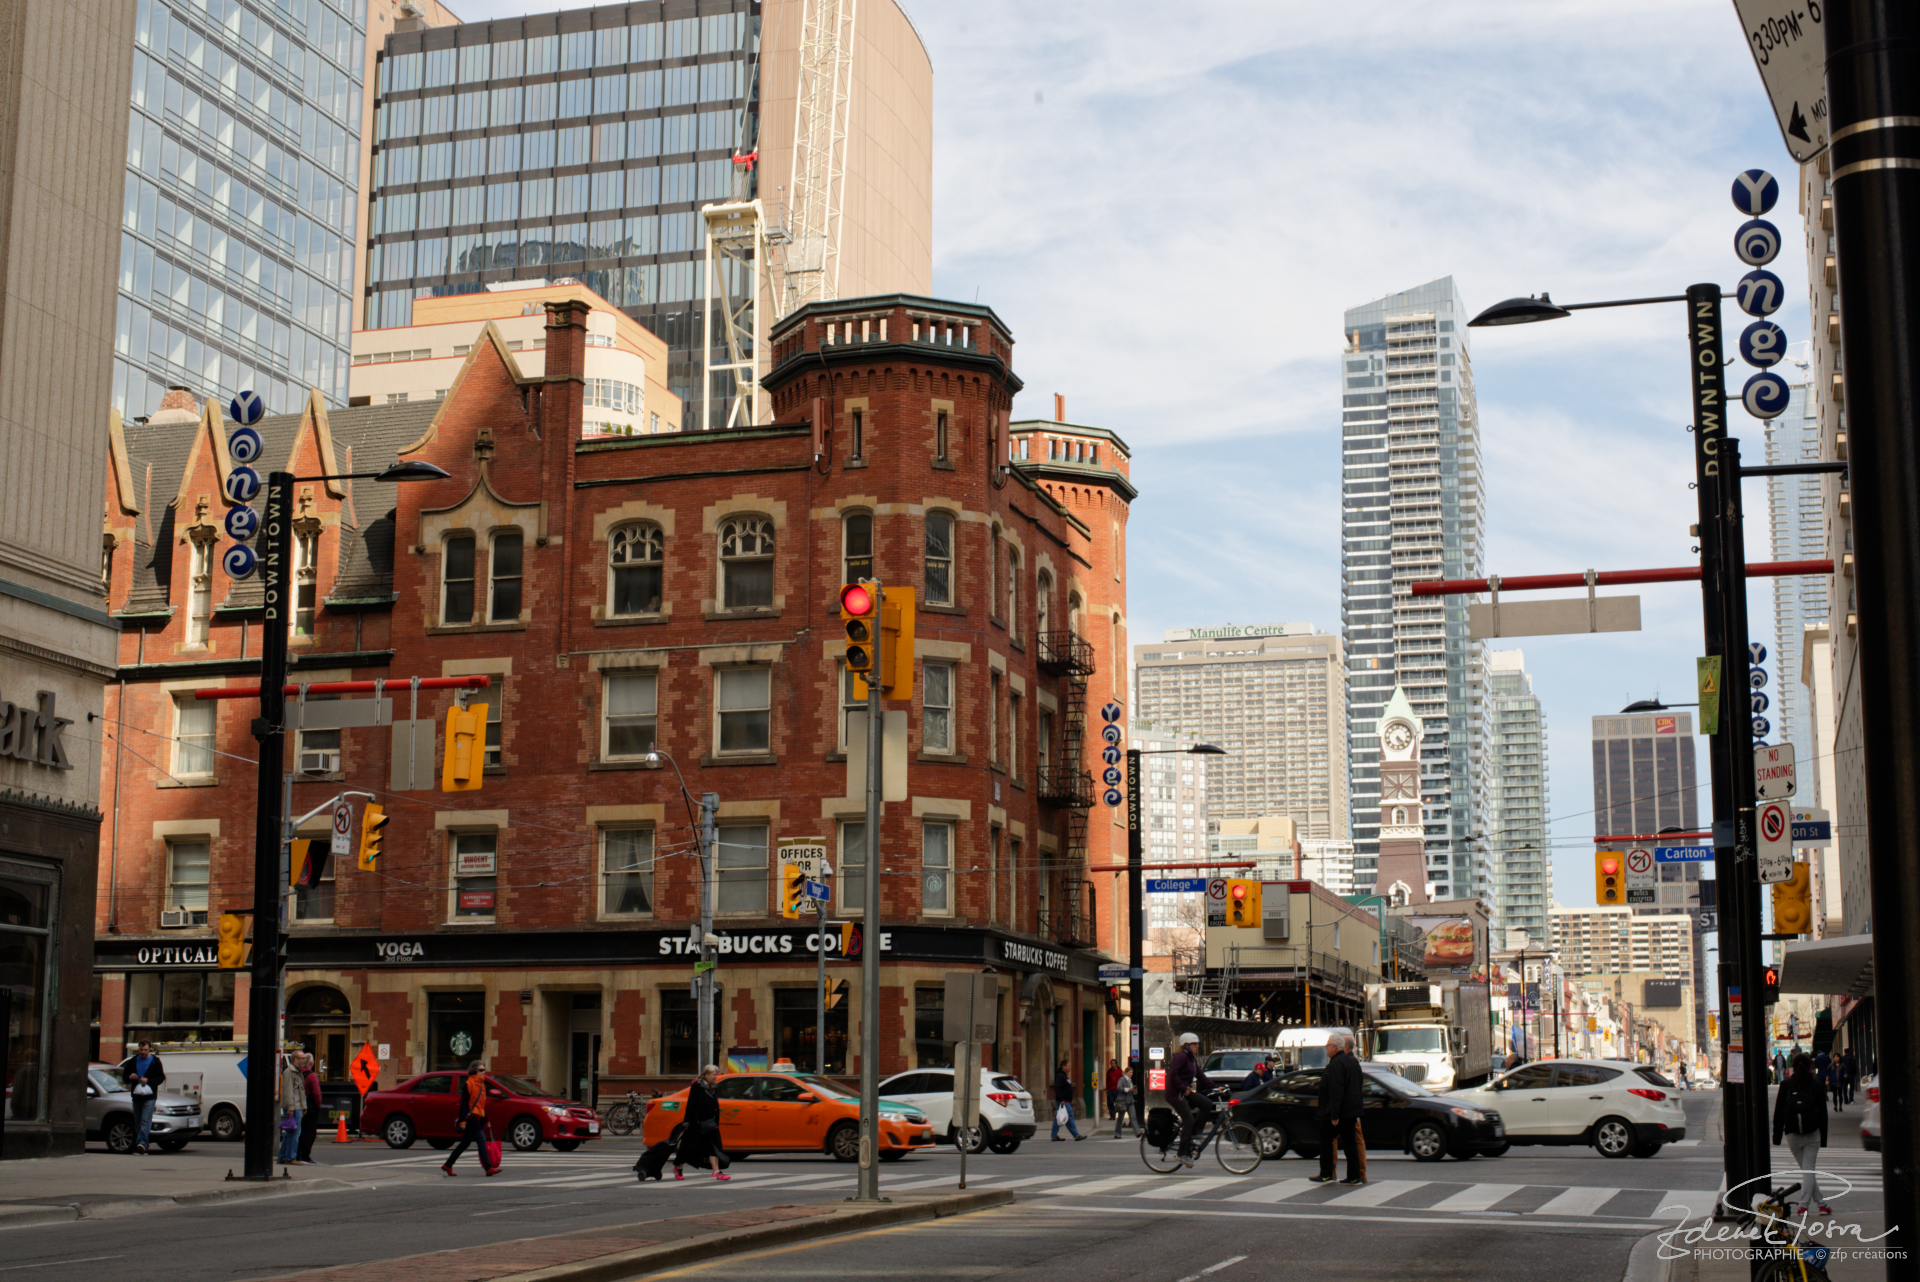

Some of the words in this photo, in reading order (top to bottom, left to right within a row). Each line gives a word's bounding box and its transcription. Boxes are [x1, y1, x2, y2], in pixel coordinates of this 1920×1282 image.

[1733, 170, 1789, 418] Yonge
[1696, 301, 1720, 477] DOWNTOWN
[223, 390, 264, 578] Yonge
[265, 485, 282, 620] DOWNTOWN
[1190, 627, 1241, 638] Manulife
[1244, 625, 1284, 636] Centre
[1701, 660, 1719, 670] NOTICE
[1102, 703, 1122, 808] Yonge
[1769, 749, 1779, 762] NO
[1757, 764, 1793, 782] STANDING
[1129, 756, 1137, 830] DOWNTOWN
[1810, 827, 1818, 836] St
[464, 855, 488, 863] VINCENT
[781, 848, 823, 859] OFFICES
[1665, 847, 1706, 859] Carlton
[794, 860, 811, 871] OR
[1154, 880, 1191, 892] College
[375, 942, 424, 956] YOGA
[806, 933, 892, 951] COE
[138, 947, 218, 963] OPTICAL
[1004, 941, 1043, 966] STARBUCKS
[1045, 950, 1068, 971] COFFEE
